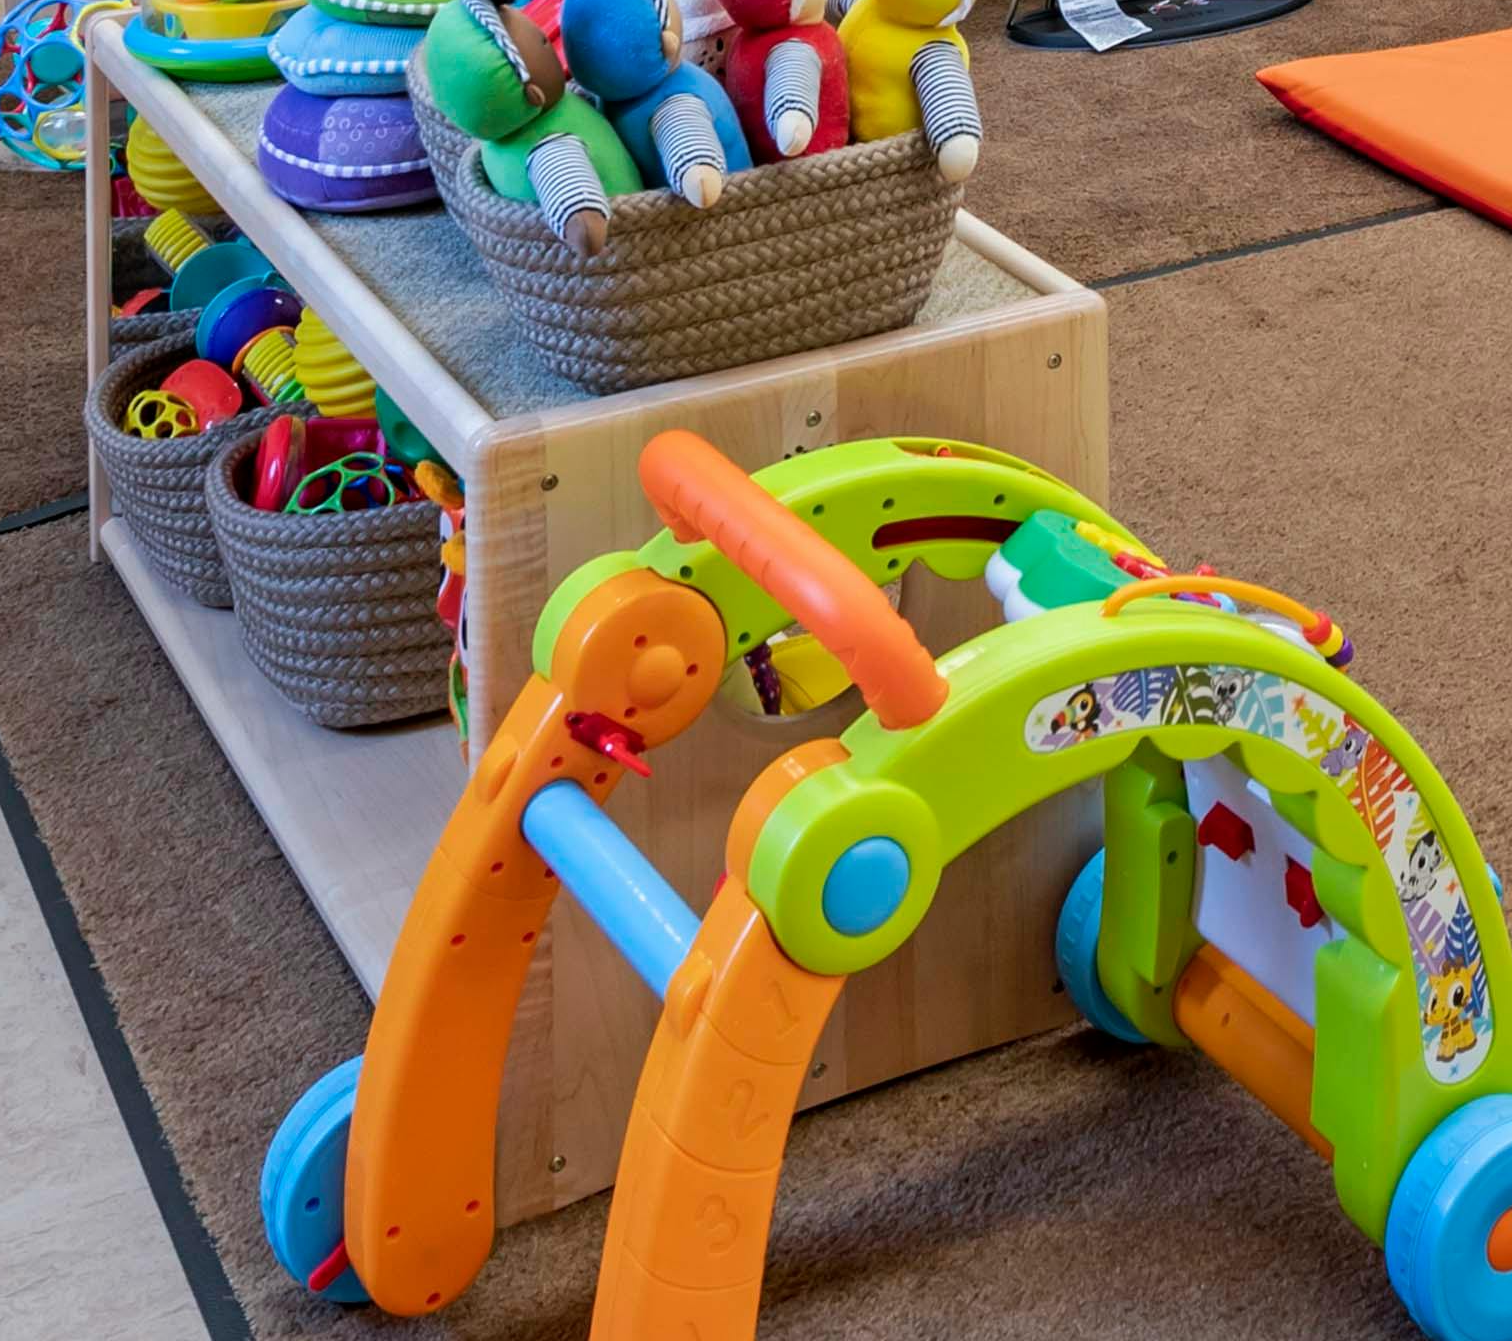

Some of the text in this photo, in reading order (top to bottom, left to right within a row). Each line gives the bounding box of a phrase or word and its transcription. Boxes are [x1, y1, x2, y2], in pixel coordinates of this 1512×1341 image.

[762, 979, 801, 1039] 1
[725, 1078, 770, 1142] 2
[693, 1192, 742, 1256] 3
